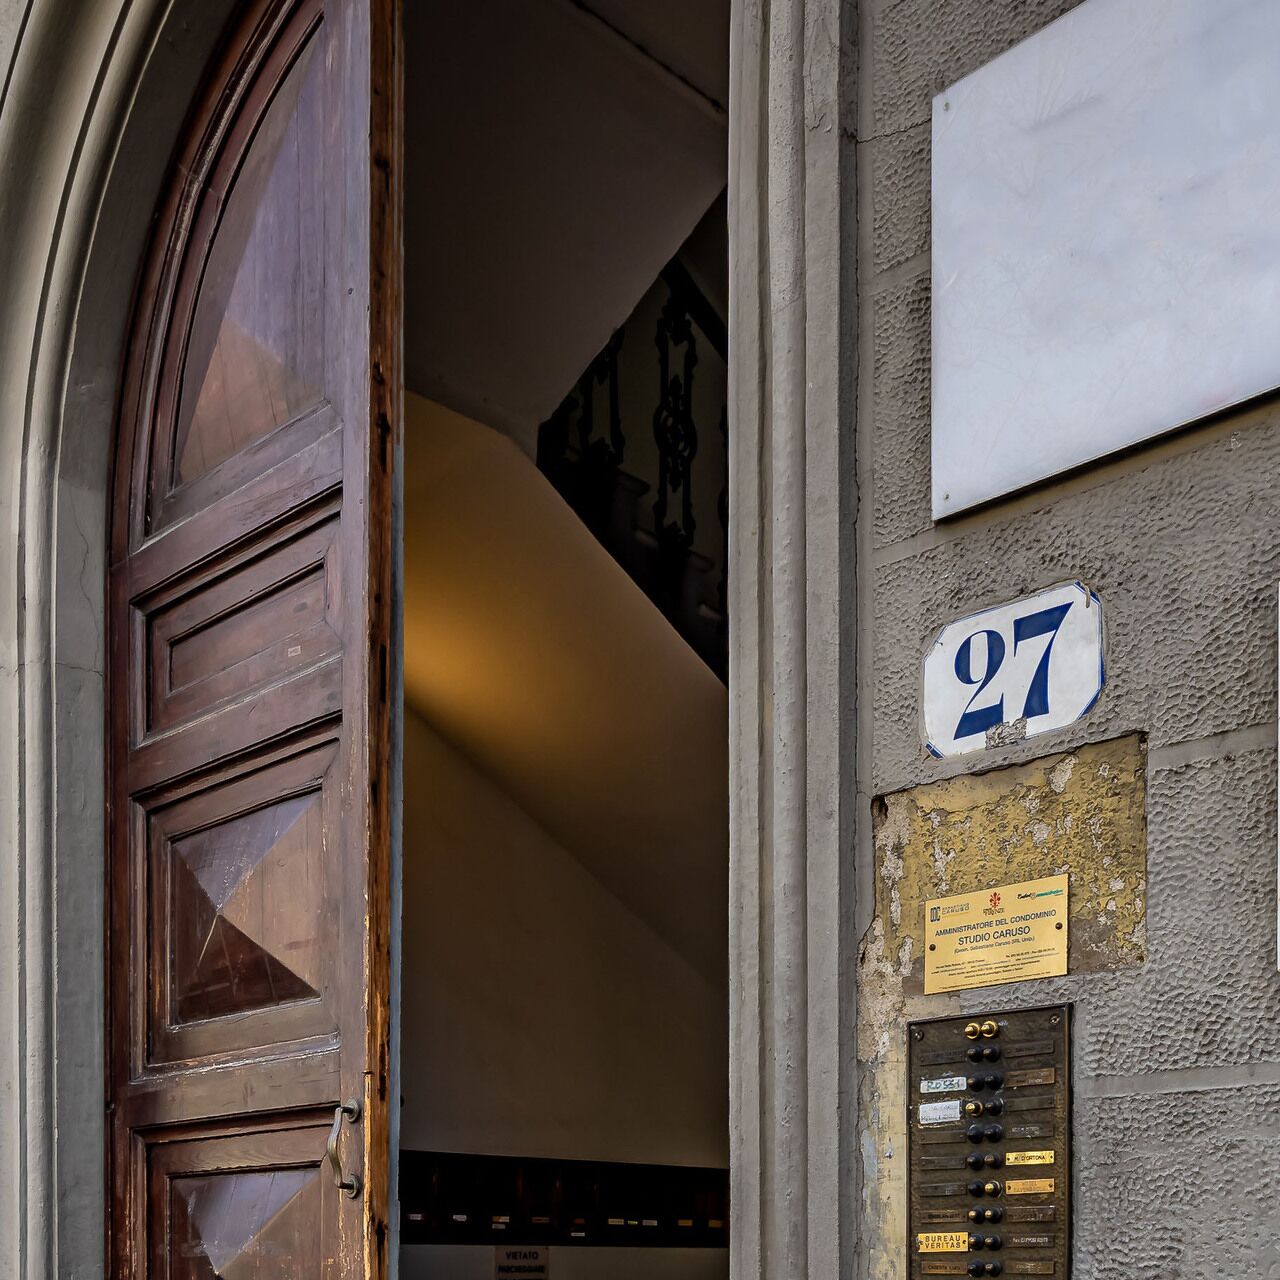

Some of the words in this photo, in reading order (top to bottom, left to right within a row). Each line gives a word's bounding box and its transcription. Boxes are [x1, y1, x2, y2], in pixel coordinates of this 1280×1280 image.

[953, 600, 1074, 740] 27
[935, 920, 993, 937] AMMINISTRATORE
[995, 918, 1008, 927] DEL
[1010, 909, 1057, 924] CONDOMINIO
[958, 932, 991, 945] STUDIO
[992, 926, 1031, 940] CARUSO
